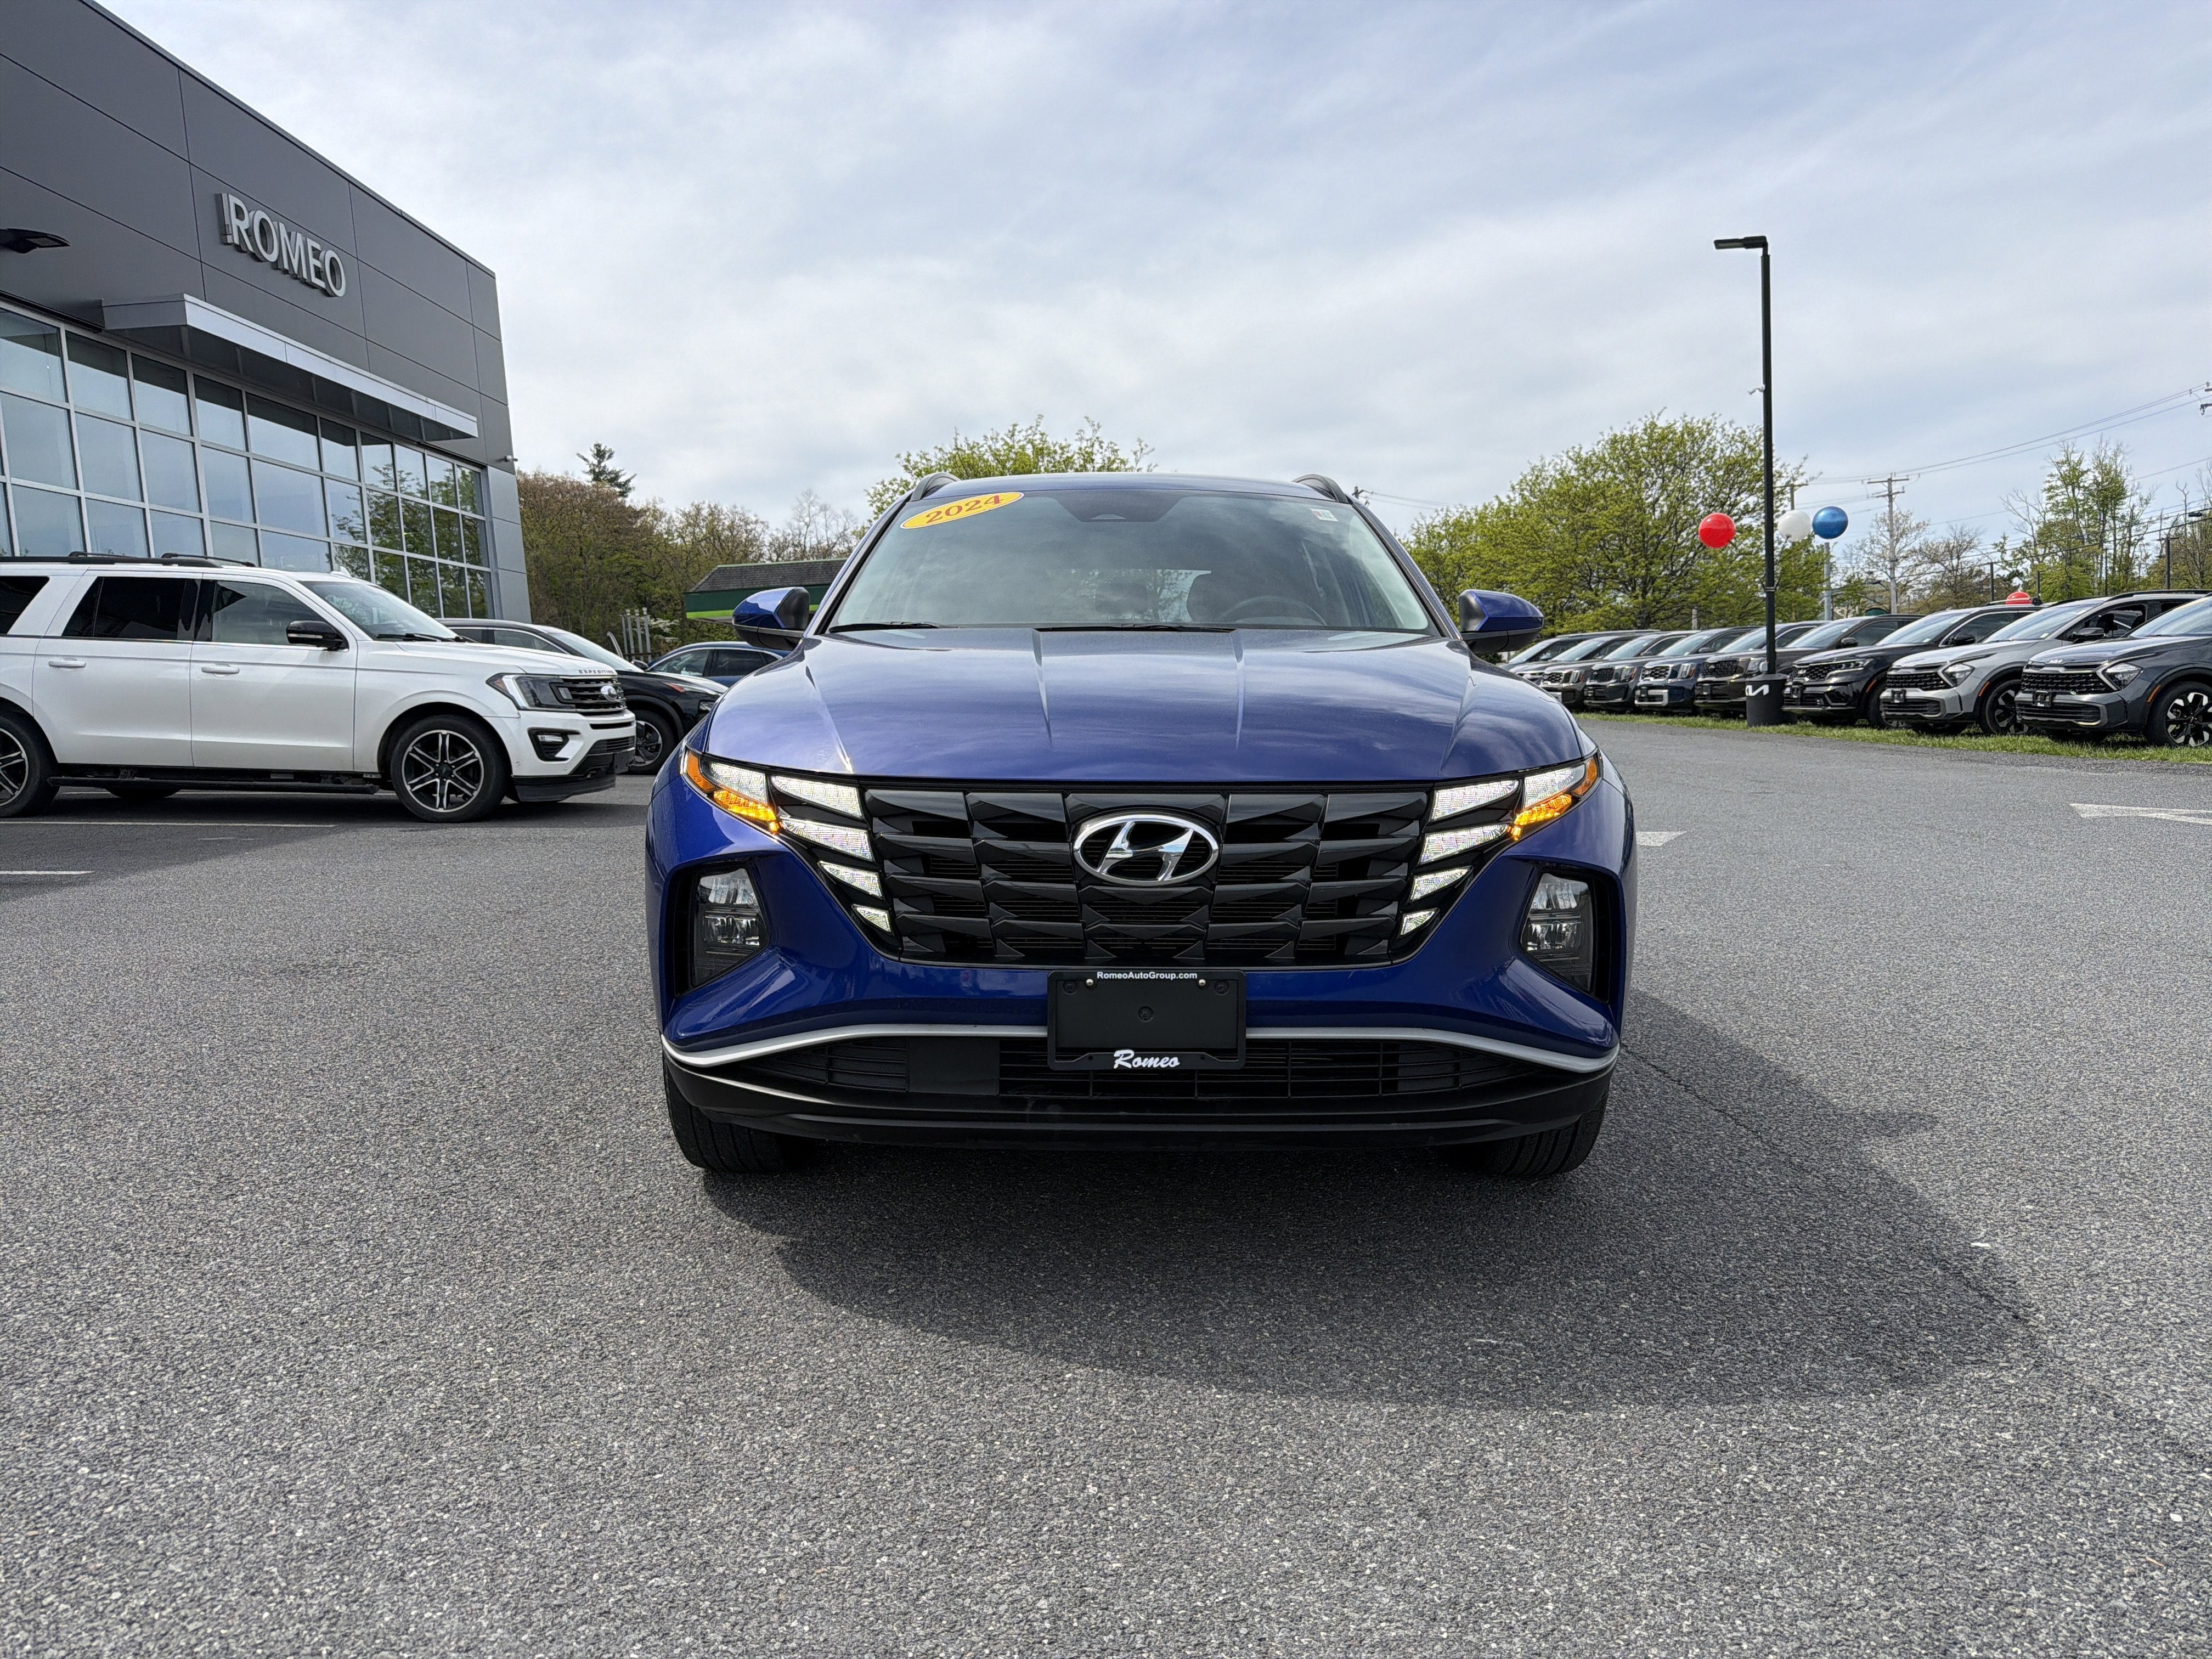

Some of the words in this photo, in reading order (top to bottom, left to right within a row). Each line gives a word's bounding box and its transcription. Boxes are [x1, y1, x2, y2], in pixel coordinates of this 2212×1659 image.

[221, 193, 346, 297] ROMEO
[926, 495, 1005, 524] 2024
[1097, 971, 1198, 980] RomeoAutoGroup.com
[1113, 1049, 1180, 1069] Romeo
